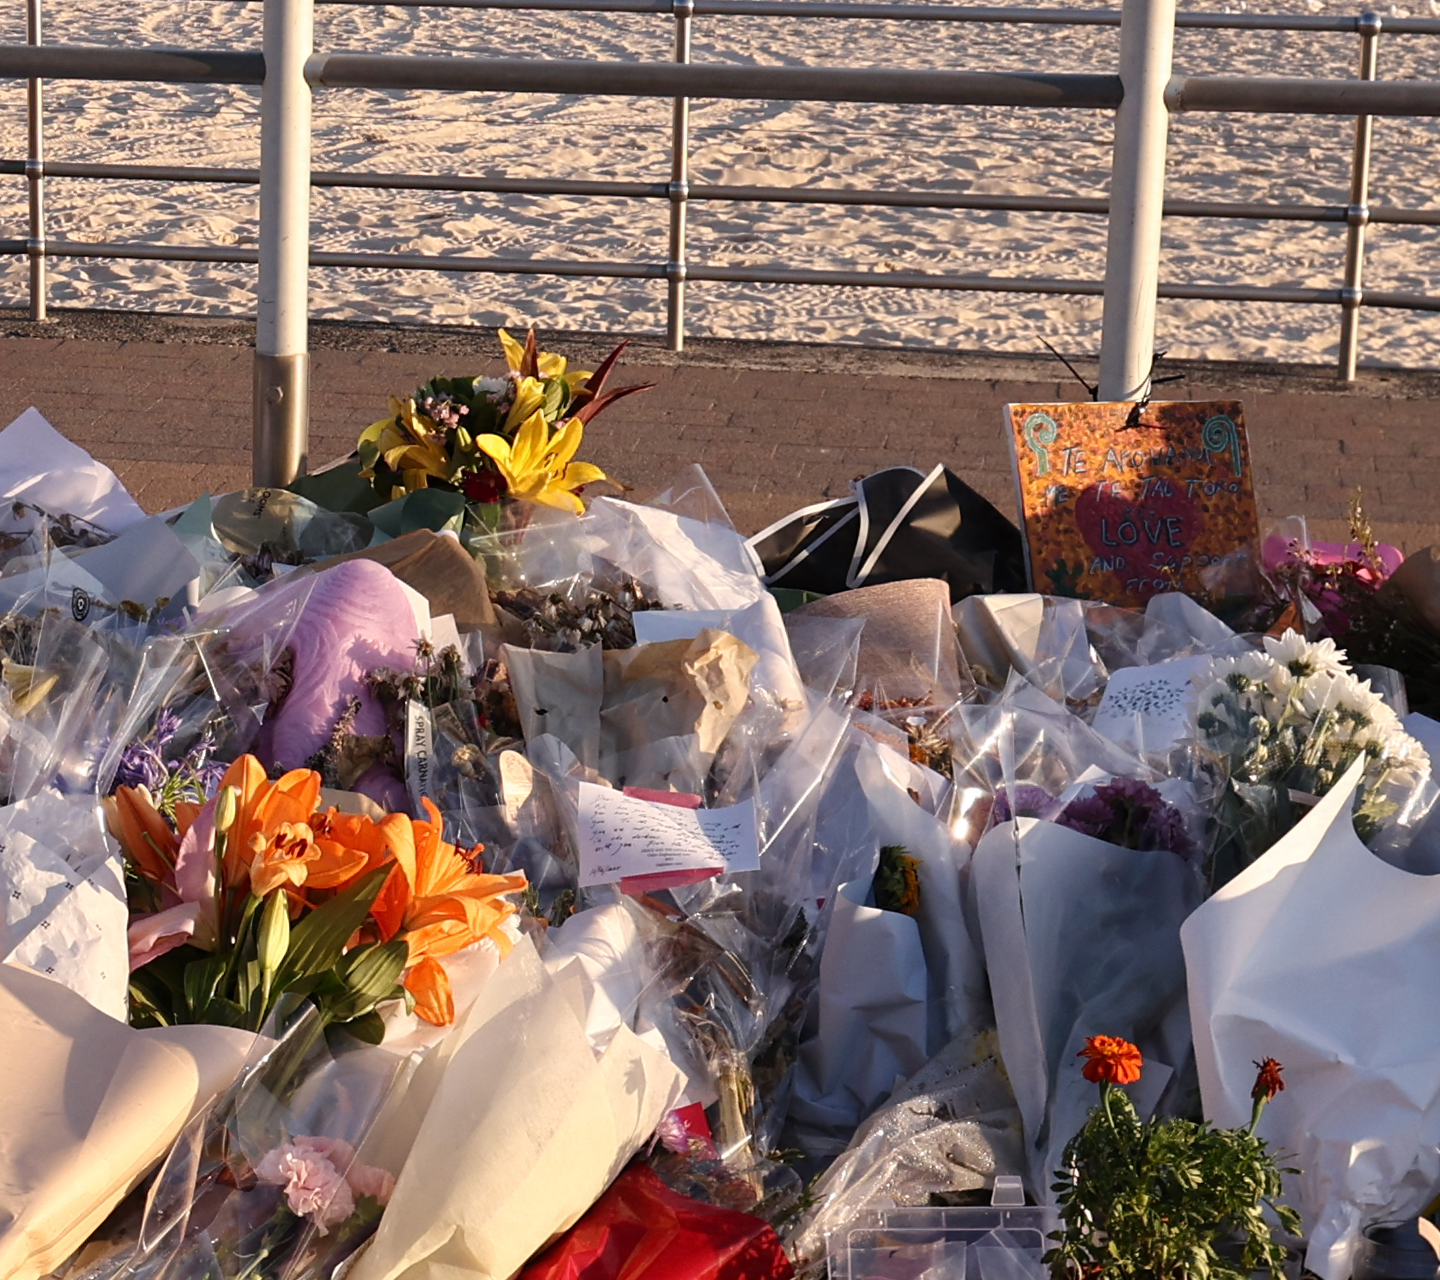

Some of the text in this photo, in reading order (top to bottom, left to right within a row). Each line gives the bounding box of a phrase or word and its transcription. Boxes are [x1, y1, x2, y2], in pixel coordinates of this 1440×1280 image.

[1062, 446, 1087, 476] TE
[253, 487, 271, 519] OOMS
[1100, 516, 1185, 547] LOVE
[1089, 555, 1127, 574] AND
[415, 715, 429, 797] SPRAY CARNATIO
